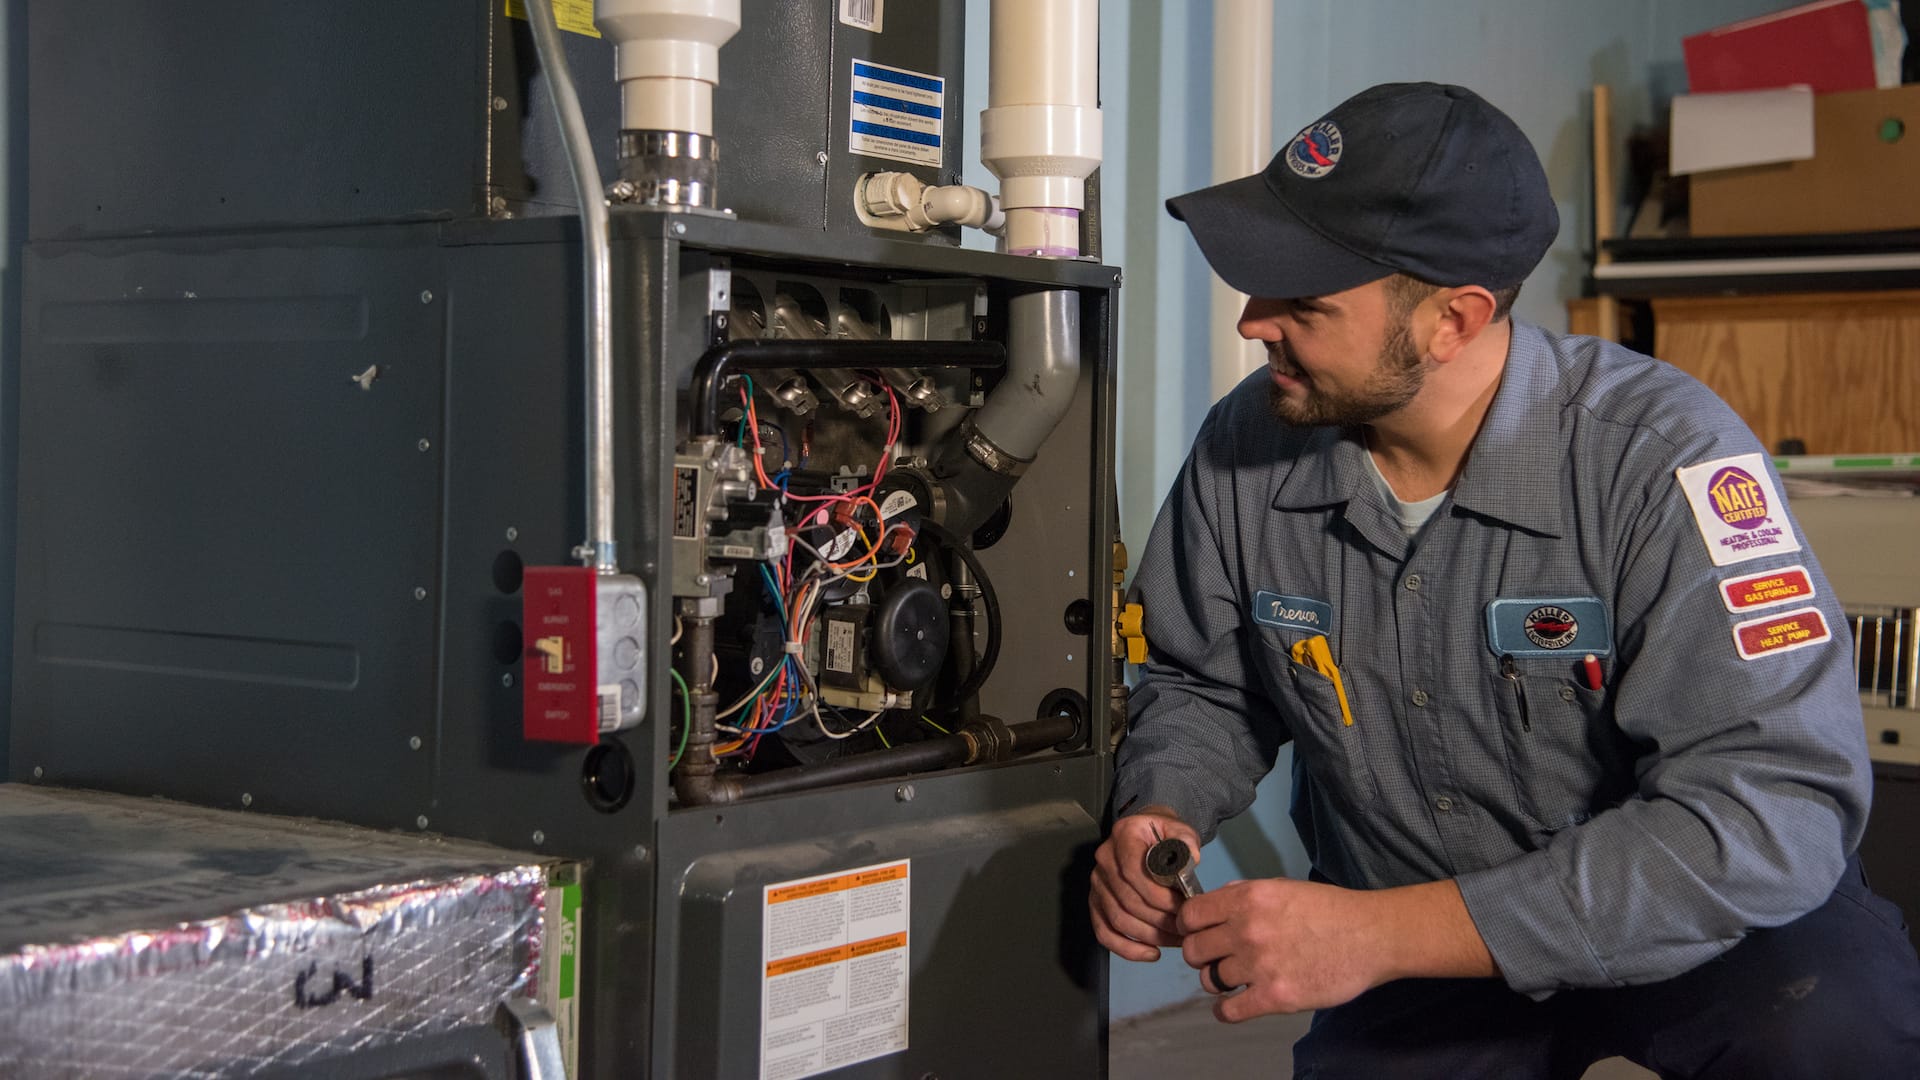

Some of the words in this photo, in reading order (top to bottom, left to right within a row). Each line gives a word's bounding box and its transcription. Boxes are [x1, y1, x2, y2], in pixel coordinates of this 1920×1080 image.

[1711, 481, 1764, 513] NATE
[1723, 507, 1766, 523] CERTIFIED
[1720, 532, 1750, 546] HEATING
[1757, 527, 1783, 537] COOLING
[1731, 536, 1780, 552] PROFESSIONAL
[1752, 578, 1785, 591] SERVICE
[1744, 592, 1764, 602] GAS
[1763, 584, 1799, 598] FURNACE
[1529, 608, 1570, 624] HALLER
[1767, 621, 1800, 635] SERVICE
[1760, 635, 1784, 648] HEAT
[1787, 629, 1811, 641] PUMP
